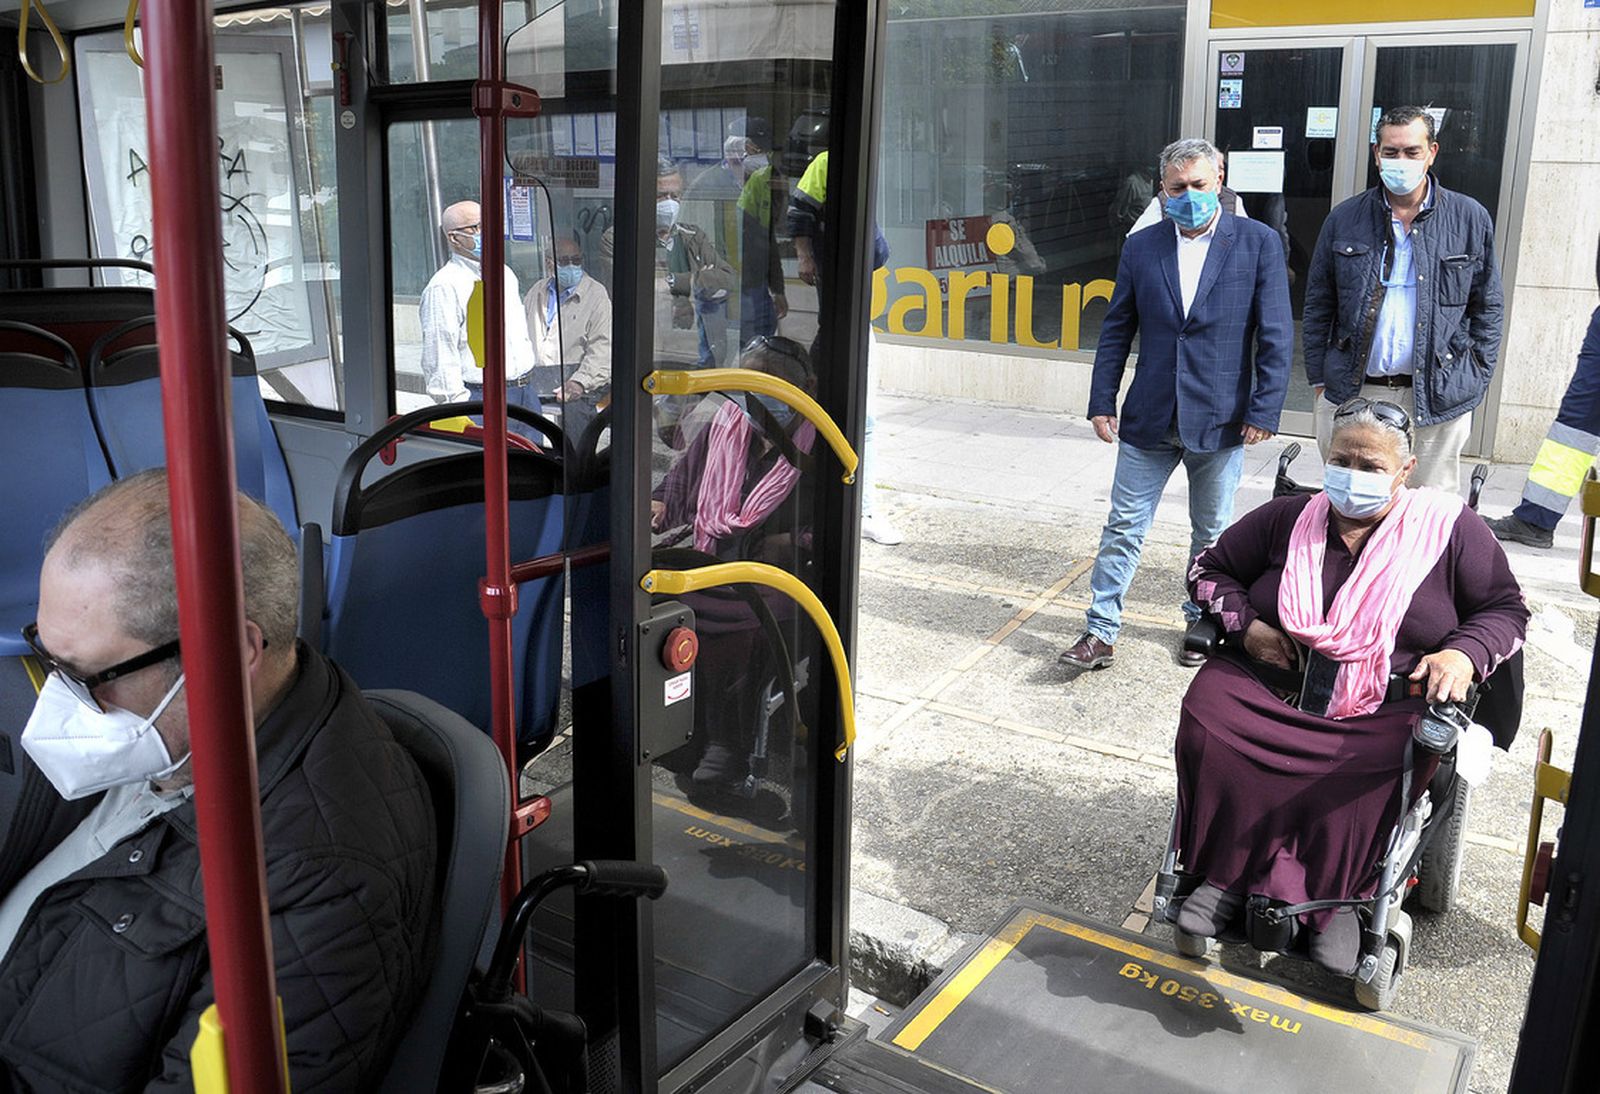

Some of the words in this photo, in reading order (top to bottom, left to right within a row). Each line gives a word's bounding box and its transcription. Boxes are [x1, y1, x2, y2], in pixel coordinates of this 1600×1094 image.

[949, 219, 967, 241] SE
[935, 241, 989, 268] ALQUILA
[1118, 962, 1160, 989] kg
[1160, 979, 1219, 1009] 350
[1223, 997, 1302, 1035] max.
